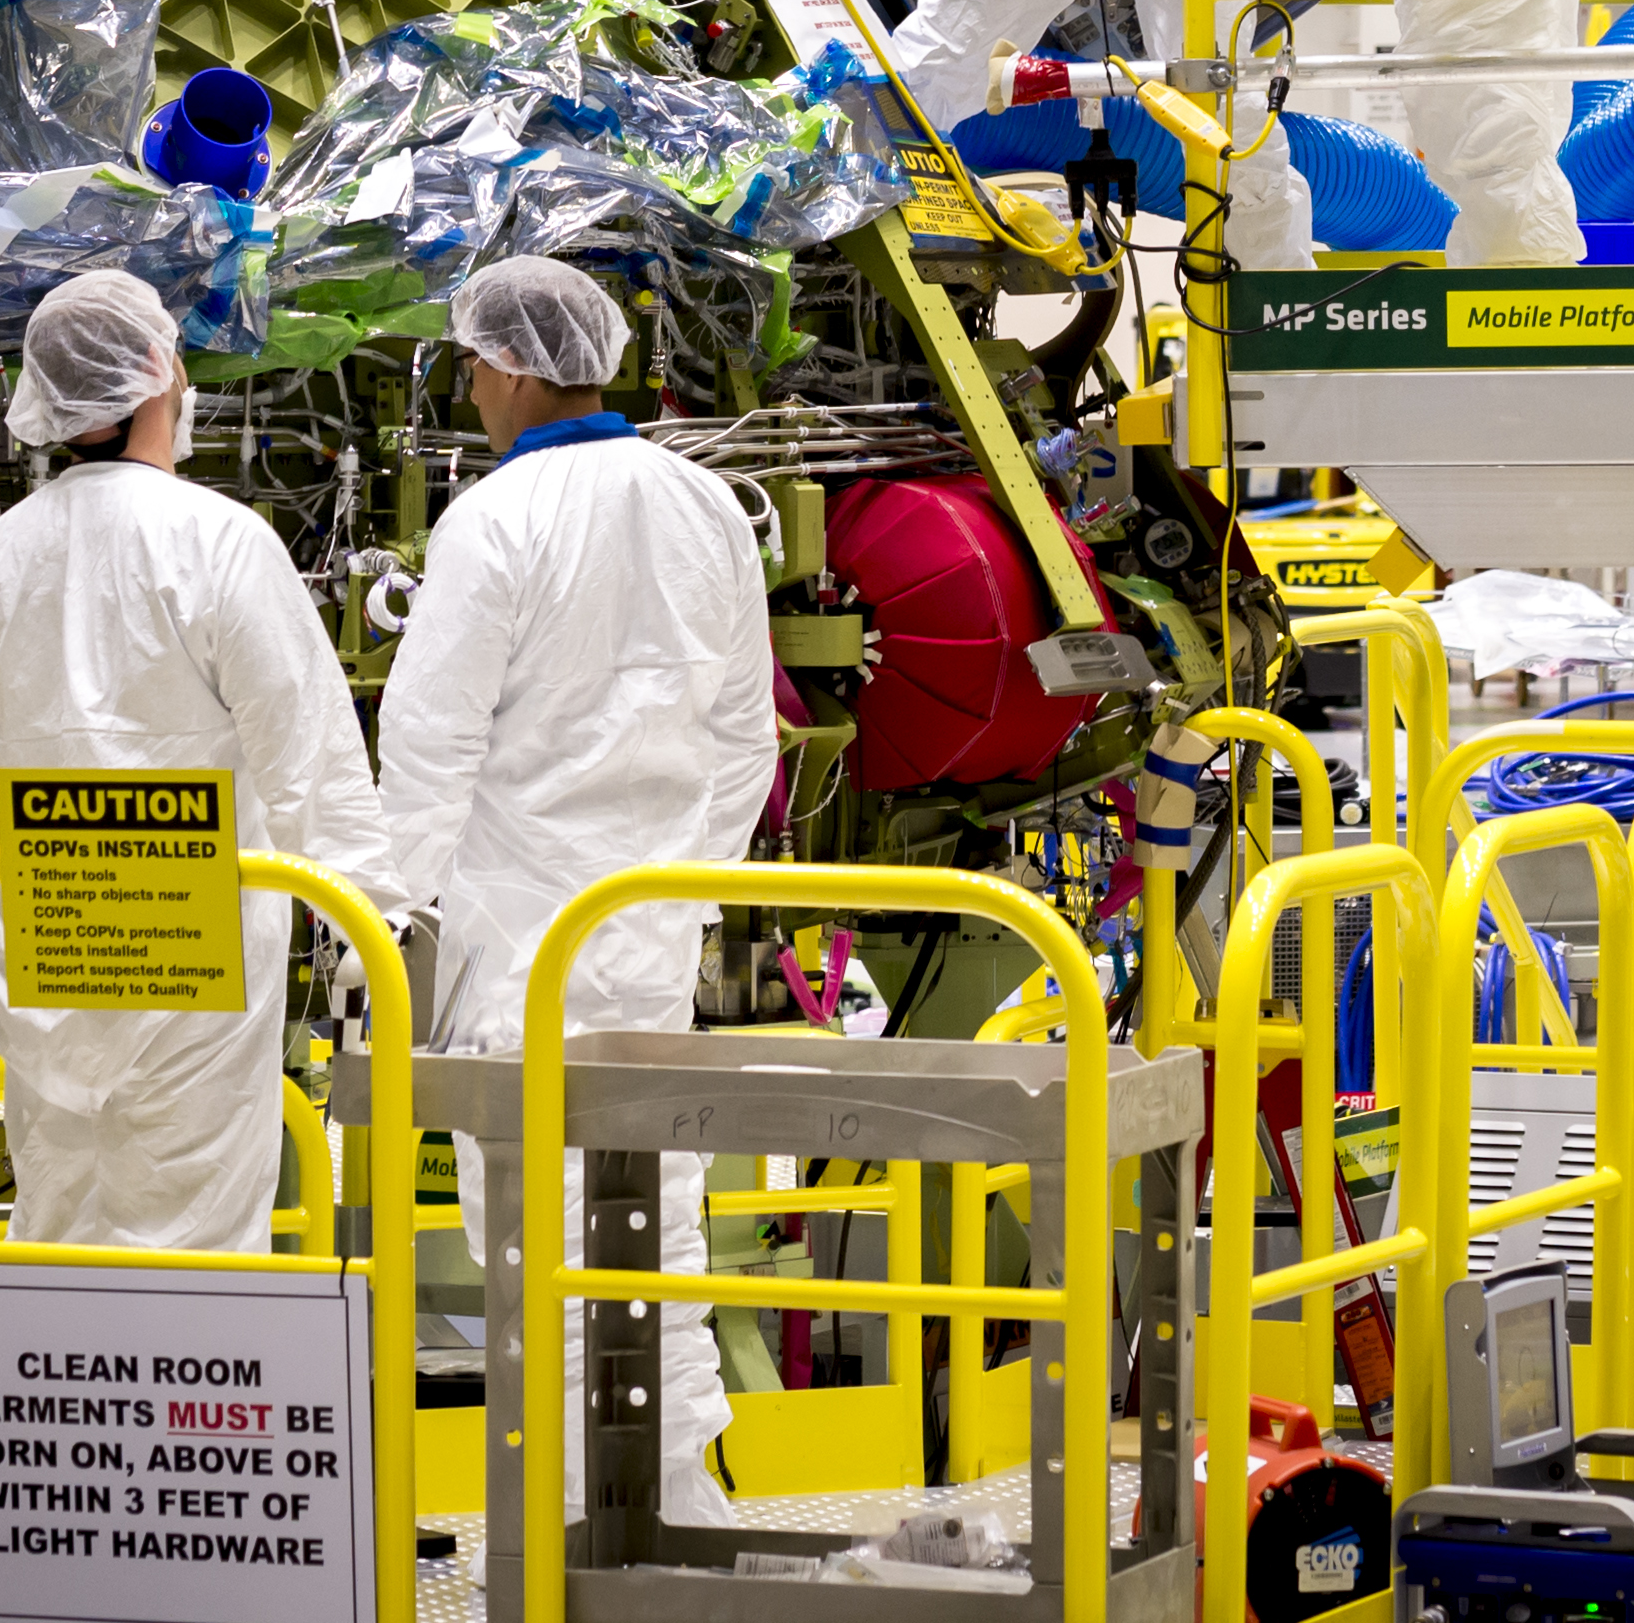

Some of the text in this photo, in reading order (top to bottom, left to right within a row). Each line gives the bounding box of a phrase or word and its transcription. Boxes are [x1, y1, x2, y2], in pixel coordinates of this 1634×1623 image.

[895, 149, 949, 175] UTIO
[948, 198, 972, 211] SPAC
[909, 220, 941, 232] UNLESS
[925, 211, 964, 224] KEEP OUT
[1263, 301, 1427, 331] MP Series
[1468, 304, 1553, 329] Mobile
[1286, 562, 1377, 584] HYSTE
[22, 789, 209, 821] CAUTION
[19, 839, 217, 858] COPVs INSTALLED
[32, 868, 116, 881] Tether tools
[33, 887, 191, 903] No sharp objects near
[34, 906, 82, 919] COVPs
[35, 925, 202, 940] Keep COPVs protective
[87, 944, 148, 957] installed
[37, 962, 225, 980] Report suspected damage
[38, 981, 199, 998] immediately to Quality
[1339, 1095, 1375, 1111] CRIT
[421, 1156, 458, 1177] Mob
[1340, 1146, 1359, 1167] obile
[17, 1352, 261, 1387] CLEAN ROOM
[168, 1401, 273, 1432] MUST
[286, 1405, 334, 1434] BE
[70, 1441, 135, 1477] ON,
[147, 1444, 273, 1476] ABOVE
[286, 1449, 339, 1479] OR
[124, 1487, 145, 1515] 3
[158, 1488, 249, 1518] FEET
[262, 1493, 310, 1521] OF
[112, 1531, 324, 1566] HARDWARE
[1296, 1543, 1359, 1571] ECKO
